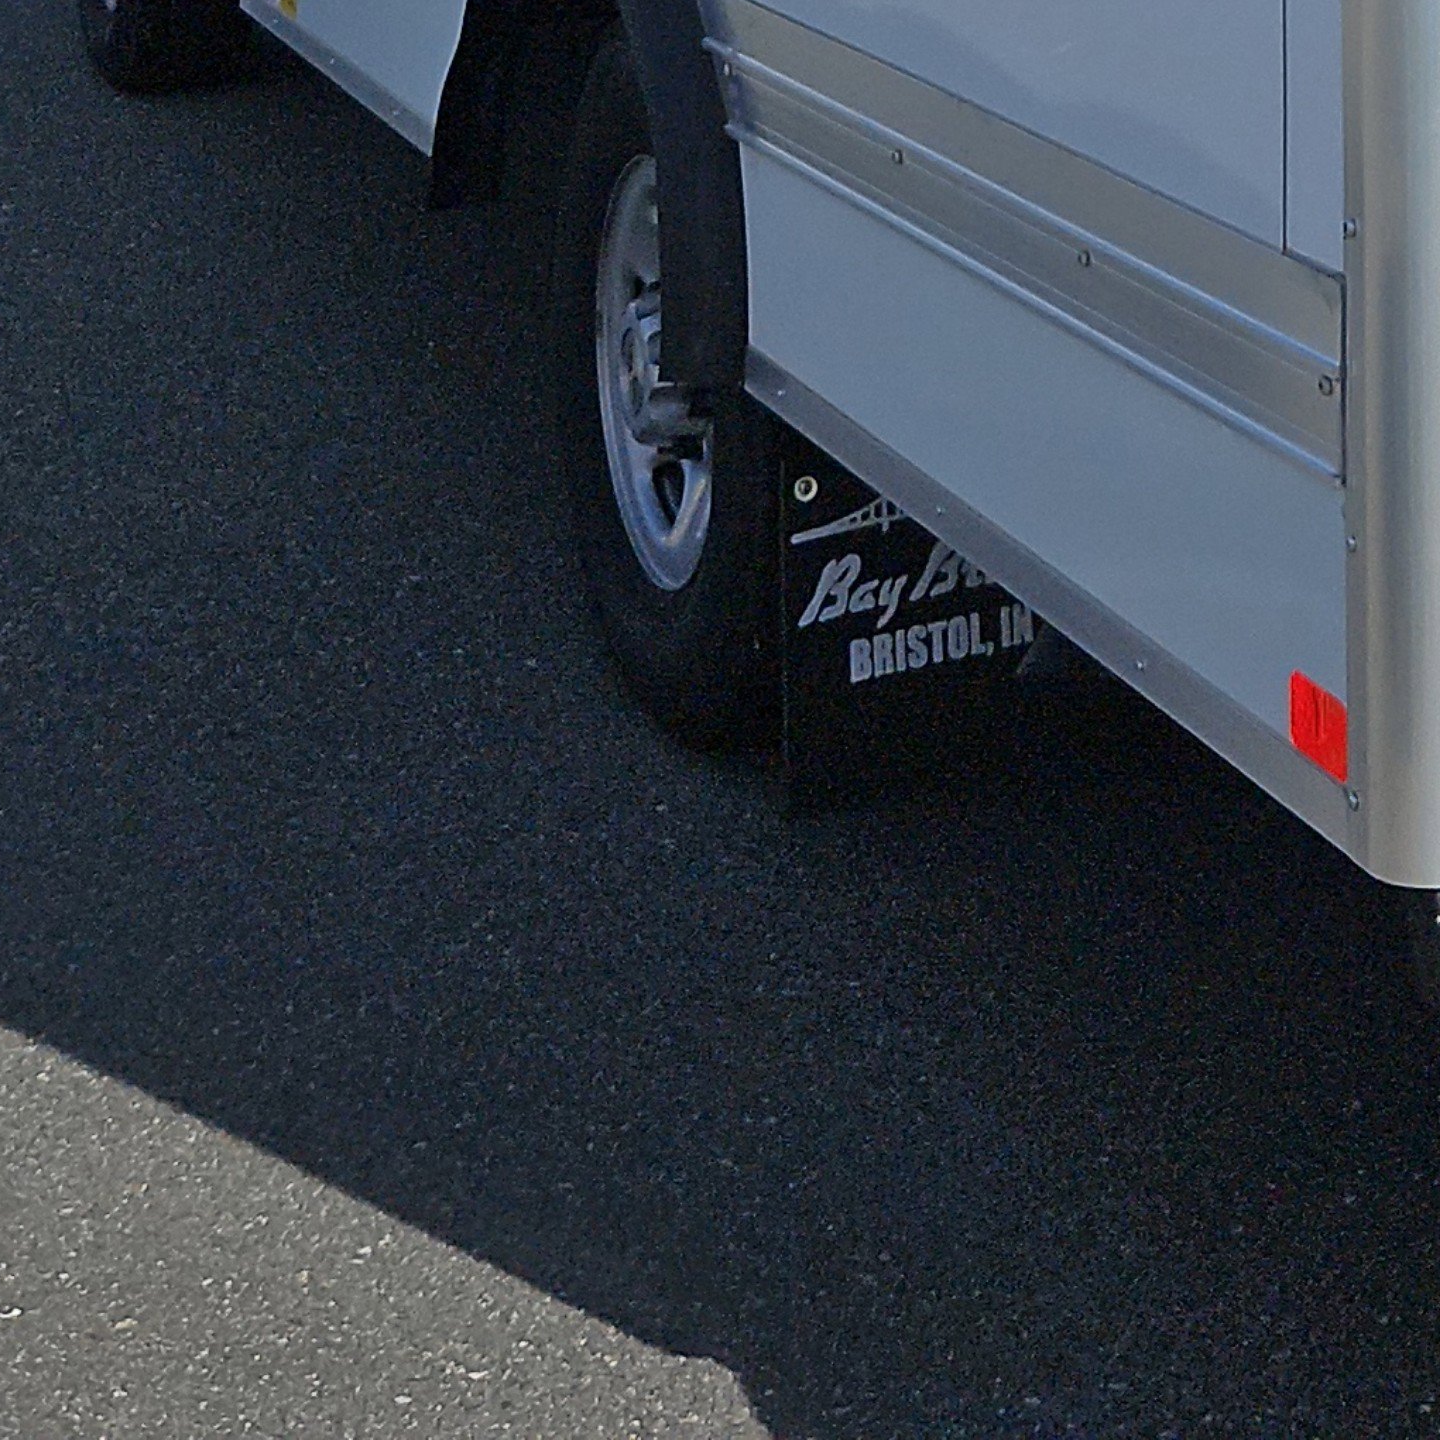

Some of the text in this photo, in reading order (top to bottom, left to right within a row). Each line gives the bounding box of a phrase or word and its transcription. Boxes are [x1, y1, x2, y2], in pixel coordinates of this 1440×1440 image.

[798, 553, 908, 629] Bay
[849, 603, 1034, 684] BRISTOL, IN
